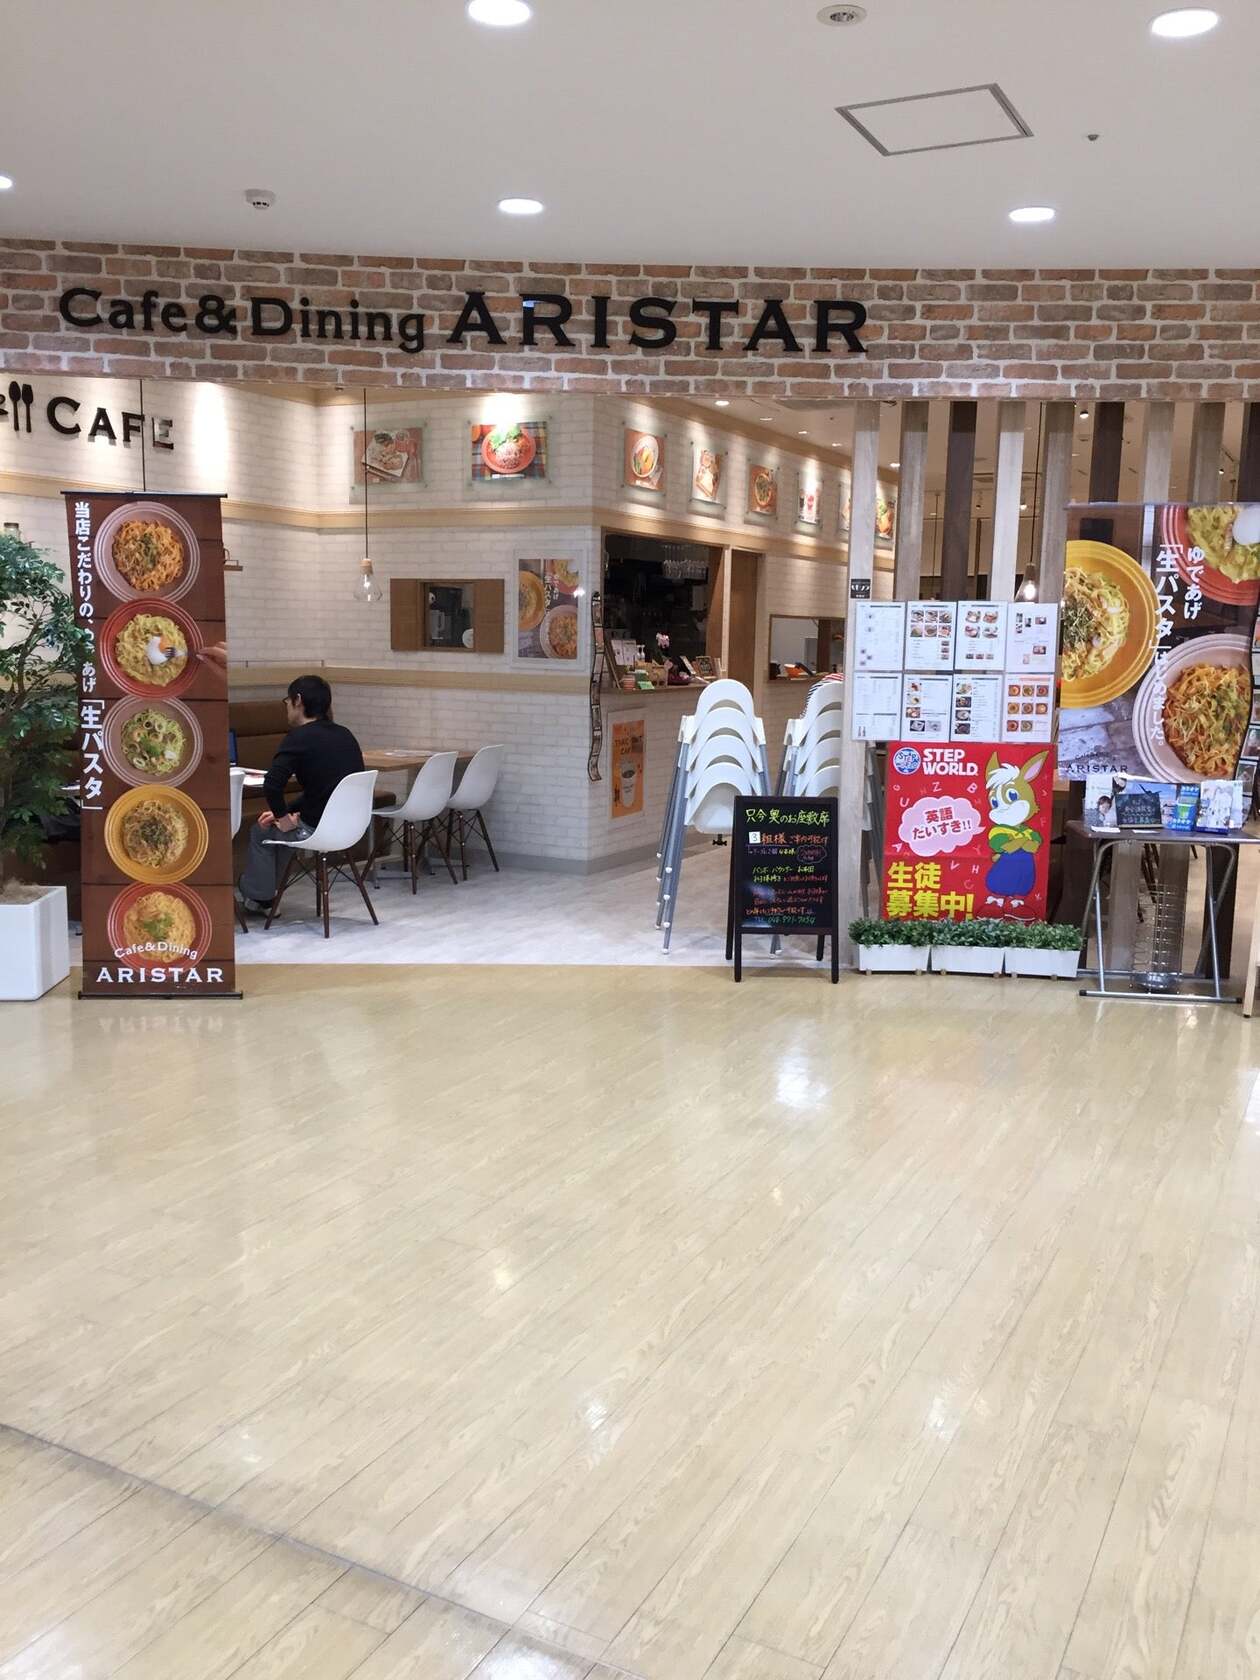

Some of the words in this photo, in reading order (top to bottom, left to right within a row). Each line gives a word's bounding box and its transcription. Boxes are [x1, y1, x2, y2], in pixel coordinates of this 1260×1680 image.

[59, 286, 425, 354] Cafe&Dining
[446, 291, 868, 353] ARISTAR
[47, 396, 174, 450] CAFE
[1184, 546, 1206, 620] ゆであげ
[923, 748, 965, 762] STEP
[922, 761, 977, 776] WORLD
[925, 806, 954, 823] 英語
[888, 861, 941, 889] 生徒
[886, 890, 974, 920] 募集中!
[114, 940, 199, 960] Cafe&Dining
[95, 967, 224, 983] ARISTAR
